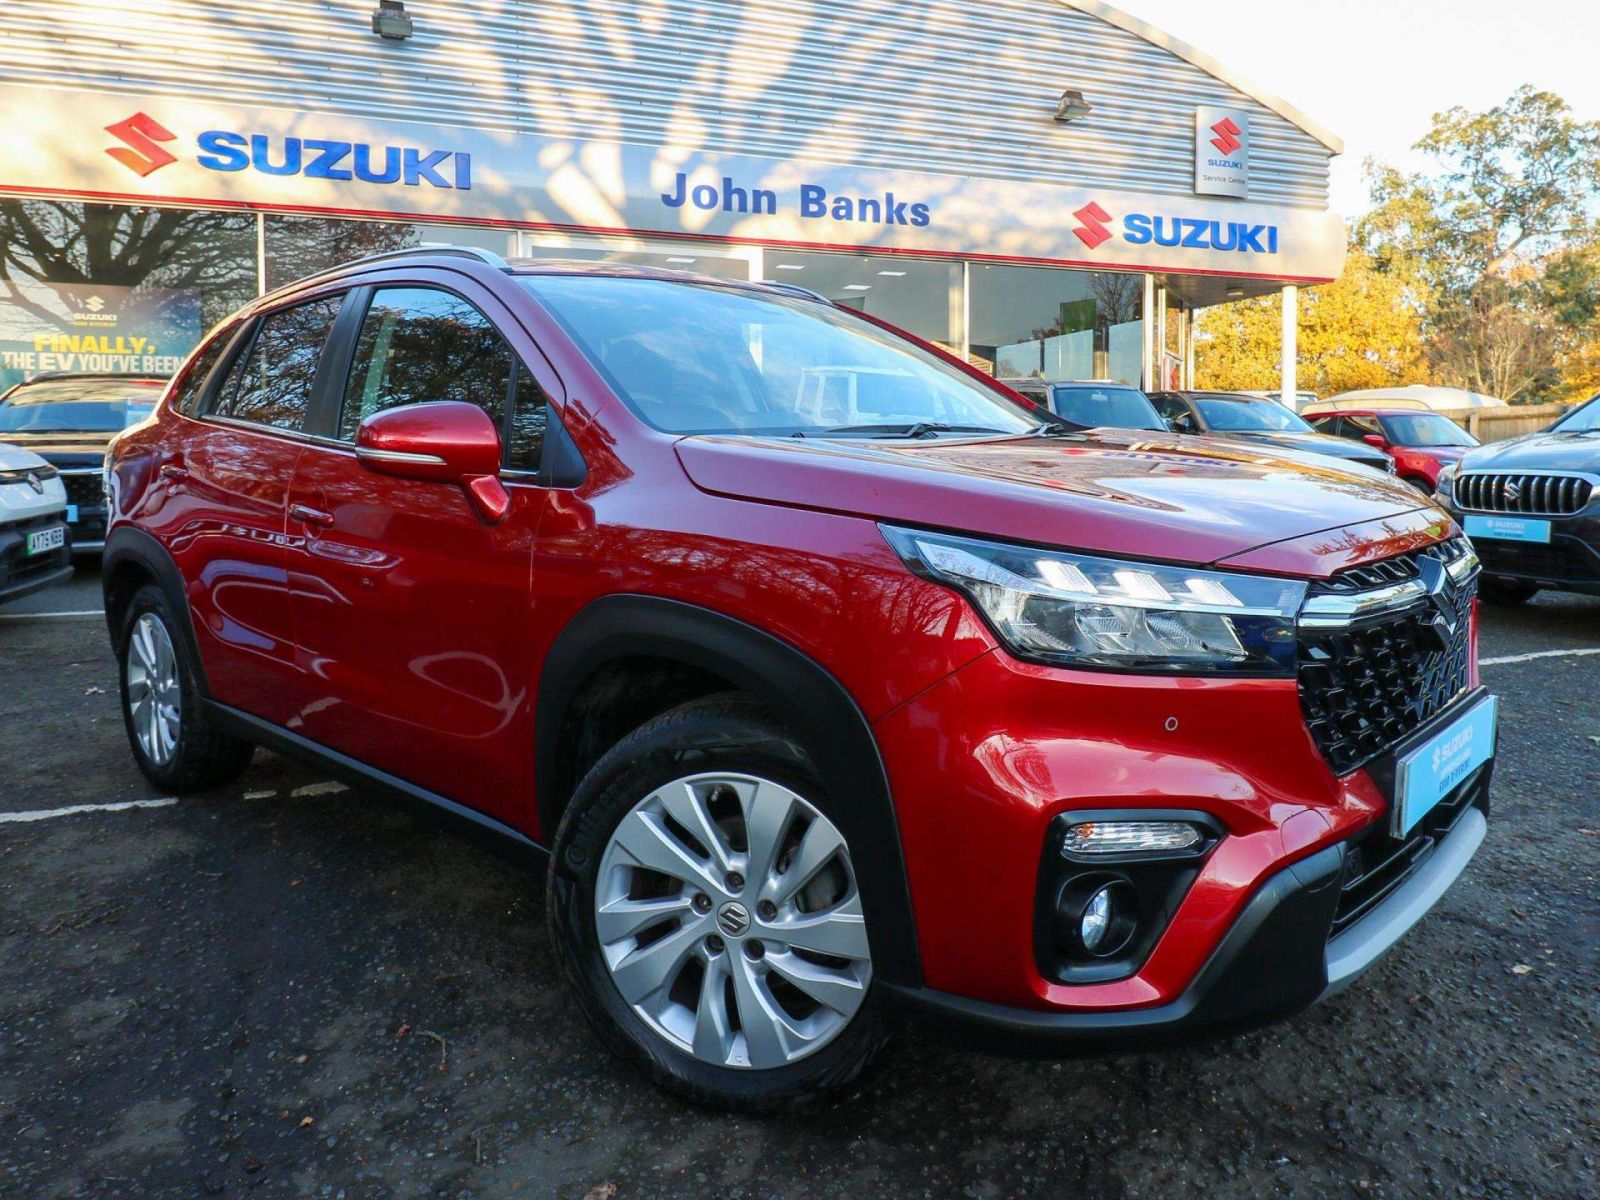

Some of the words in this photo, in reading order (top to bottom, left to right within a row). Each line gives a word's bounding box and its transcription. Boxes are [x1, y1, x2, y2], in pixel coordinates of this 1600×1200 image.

[197, 130, 471, 191] SUZUKI
[1207, 159, 1243, 170] SUZUKI
[1202, 174, 1227, 183] Service
[661, 173, 777, 215] John
[800, 184, 931, 227] Banks
[1123, 213, 1278, 254] SUZUKI
[74, 313, 117, 321] SUZUKI
[34, 335, 156, 354] FINALLY,
[3, 352, 35, 370] THE
[39, 353, 76, 371] EV
[78, 354, 140, 373] YOU'VE
